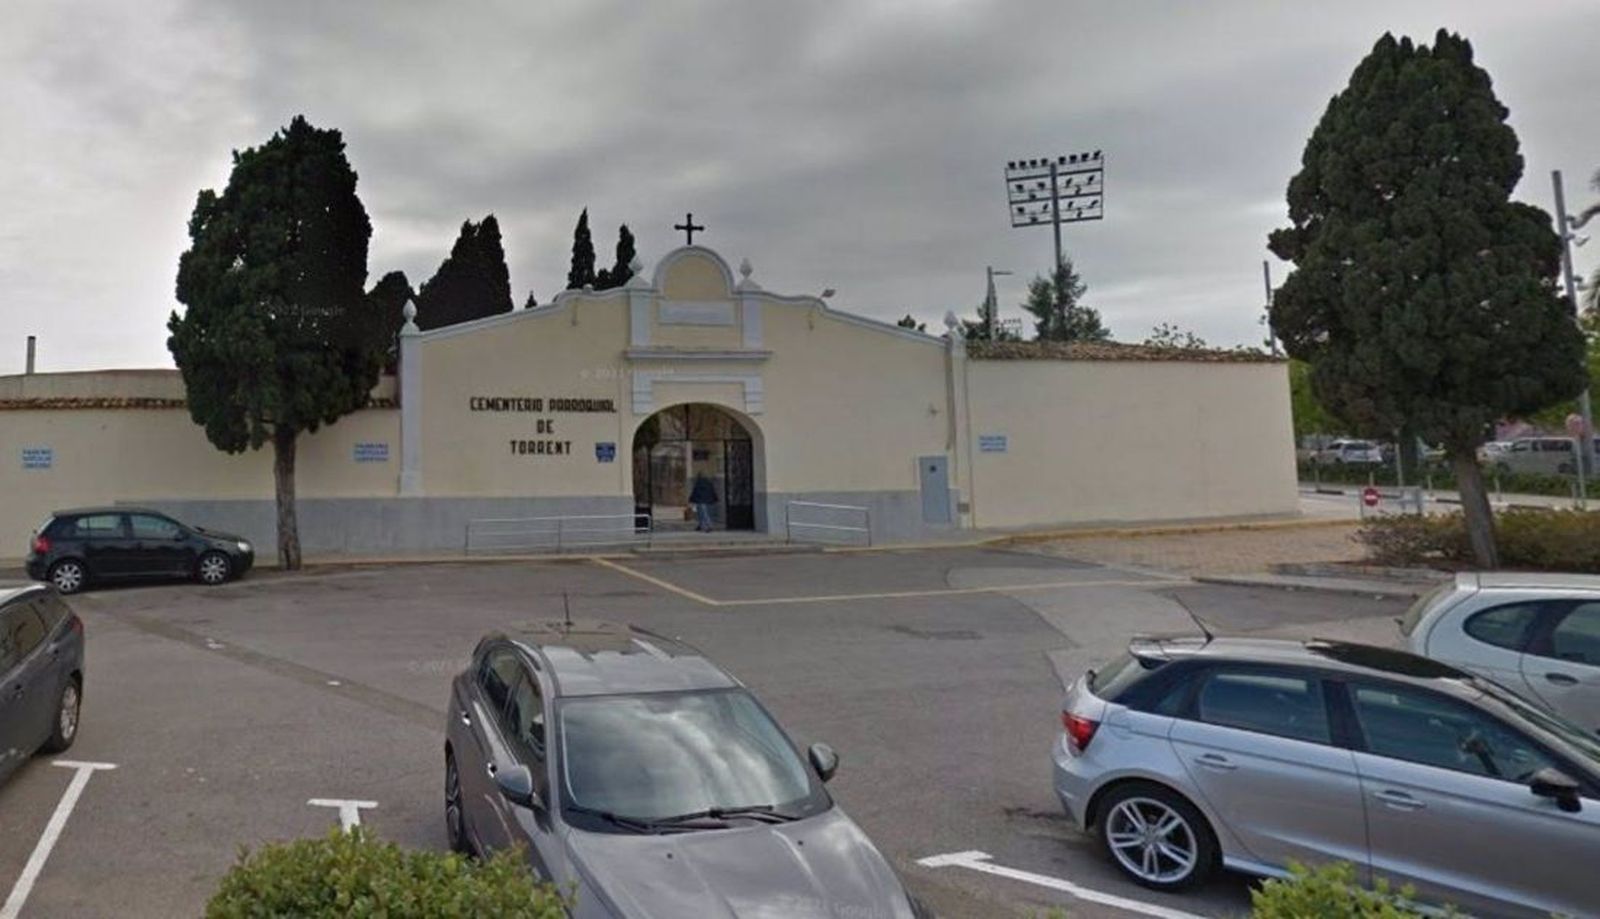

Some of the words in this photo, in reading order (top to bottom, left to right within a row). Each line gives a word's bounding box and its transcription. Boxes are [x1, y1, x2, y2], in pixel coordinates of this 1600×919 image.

[470, 397, 542, 412] CEMENTERIO
[550, 398, 617, 413] PARROQUIAL
[537, 420, 554, 434] DE
[511, 440, 571, 455] TORRENT
